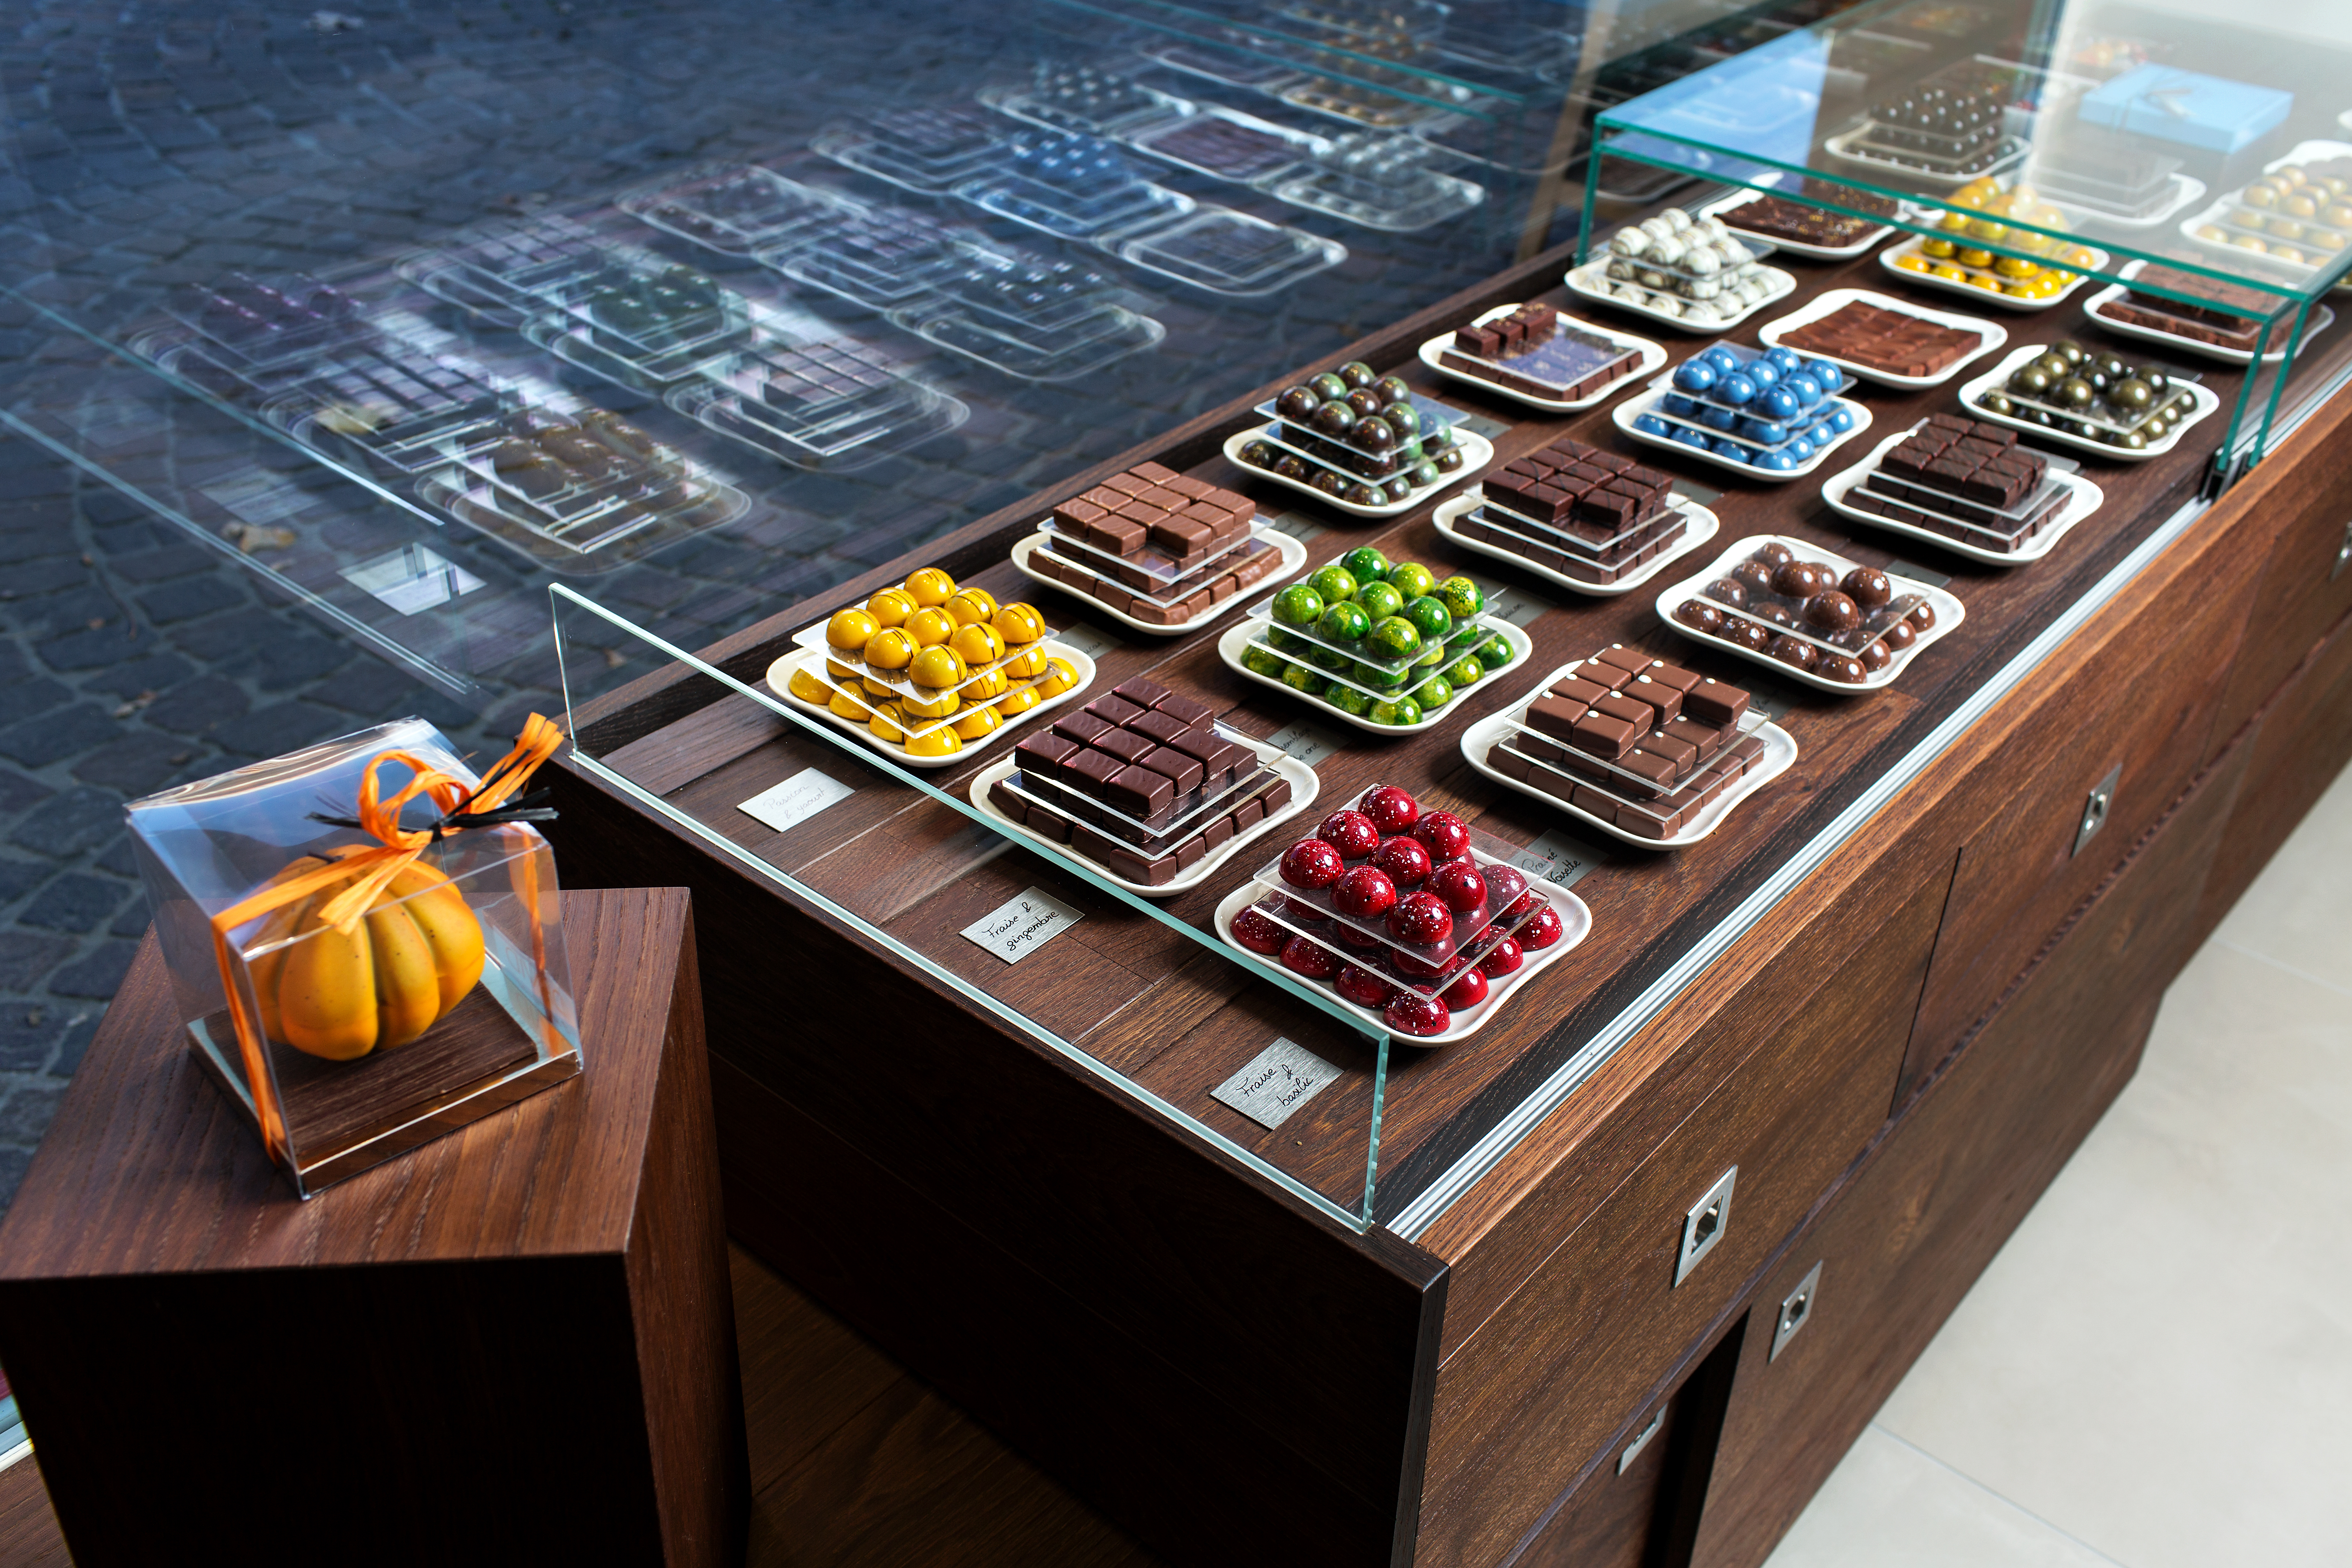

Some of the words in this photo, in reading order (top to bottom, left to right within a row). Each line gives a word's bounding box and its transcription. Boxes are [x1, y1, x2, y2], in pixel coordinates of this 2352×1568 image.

[1281, 727, 1310, 749] semblage
[1305, 742, 1320, 754] one
[763, 785, 809, 809] Passion
[784, 810, 791, 819] &
[797, 788, 825, 815] yaourt
[1521, 848, 1557, 873] Praliné
[1546, 860, 1581, 883] Noisette
[982, 915, 1019, 938] Fraise
[1022, 902, 1031, 913] &
[1007, 911, 1060, 951] gingembre
[1236, 1068, 1276, 1097] Fraise
[1282, 1064, 1293, 1080] &
[1276, 1077, 1313, 1106] basilic
